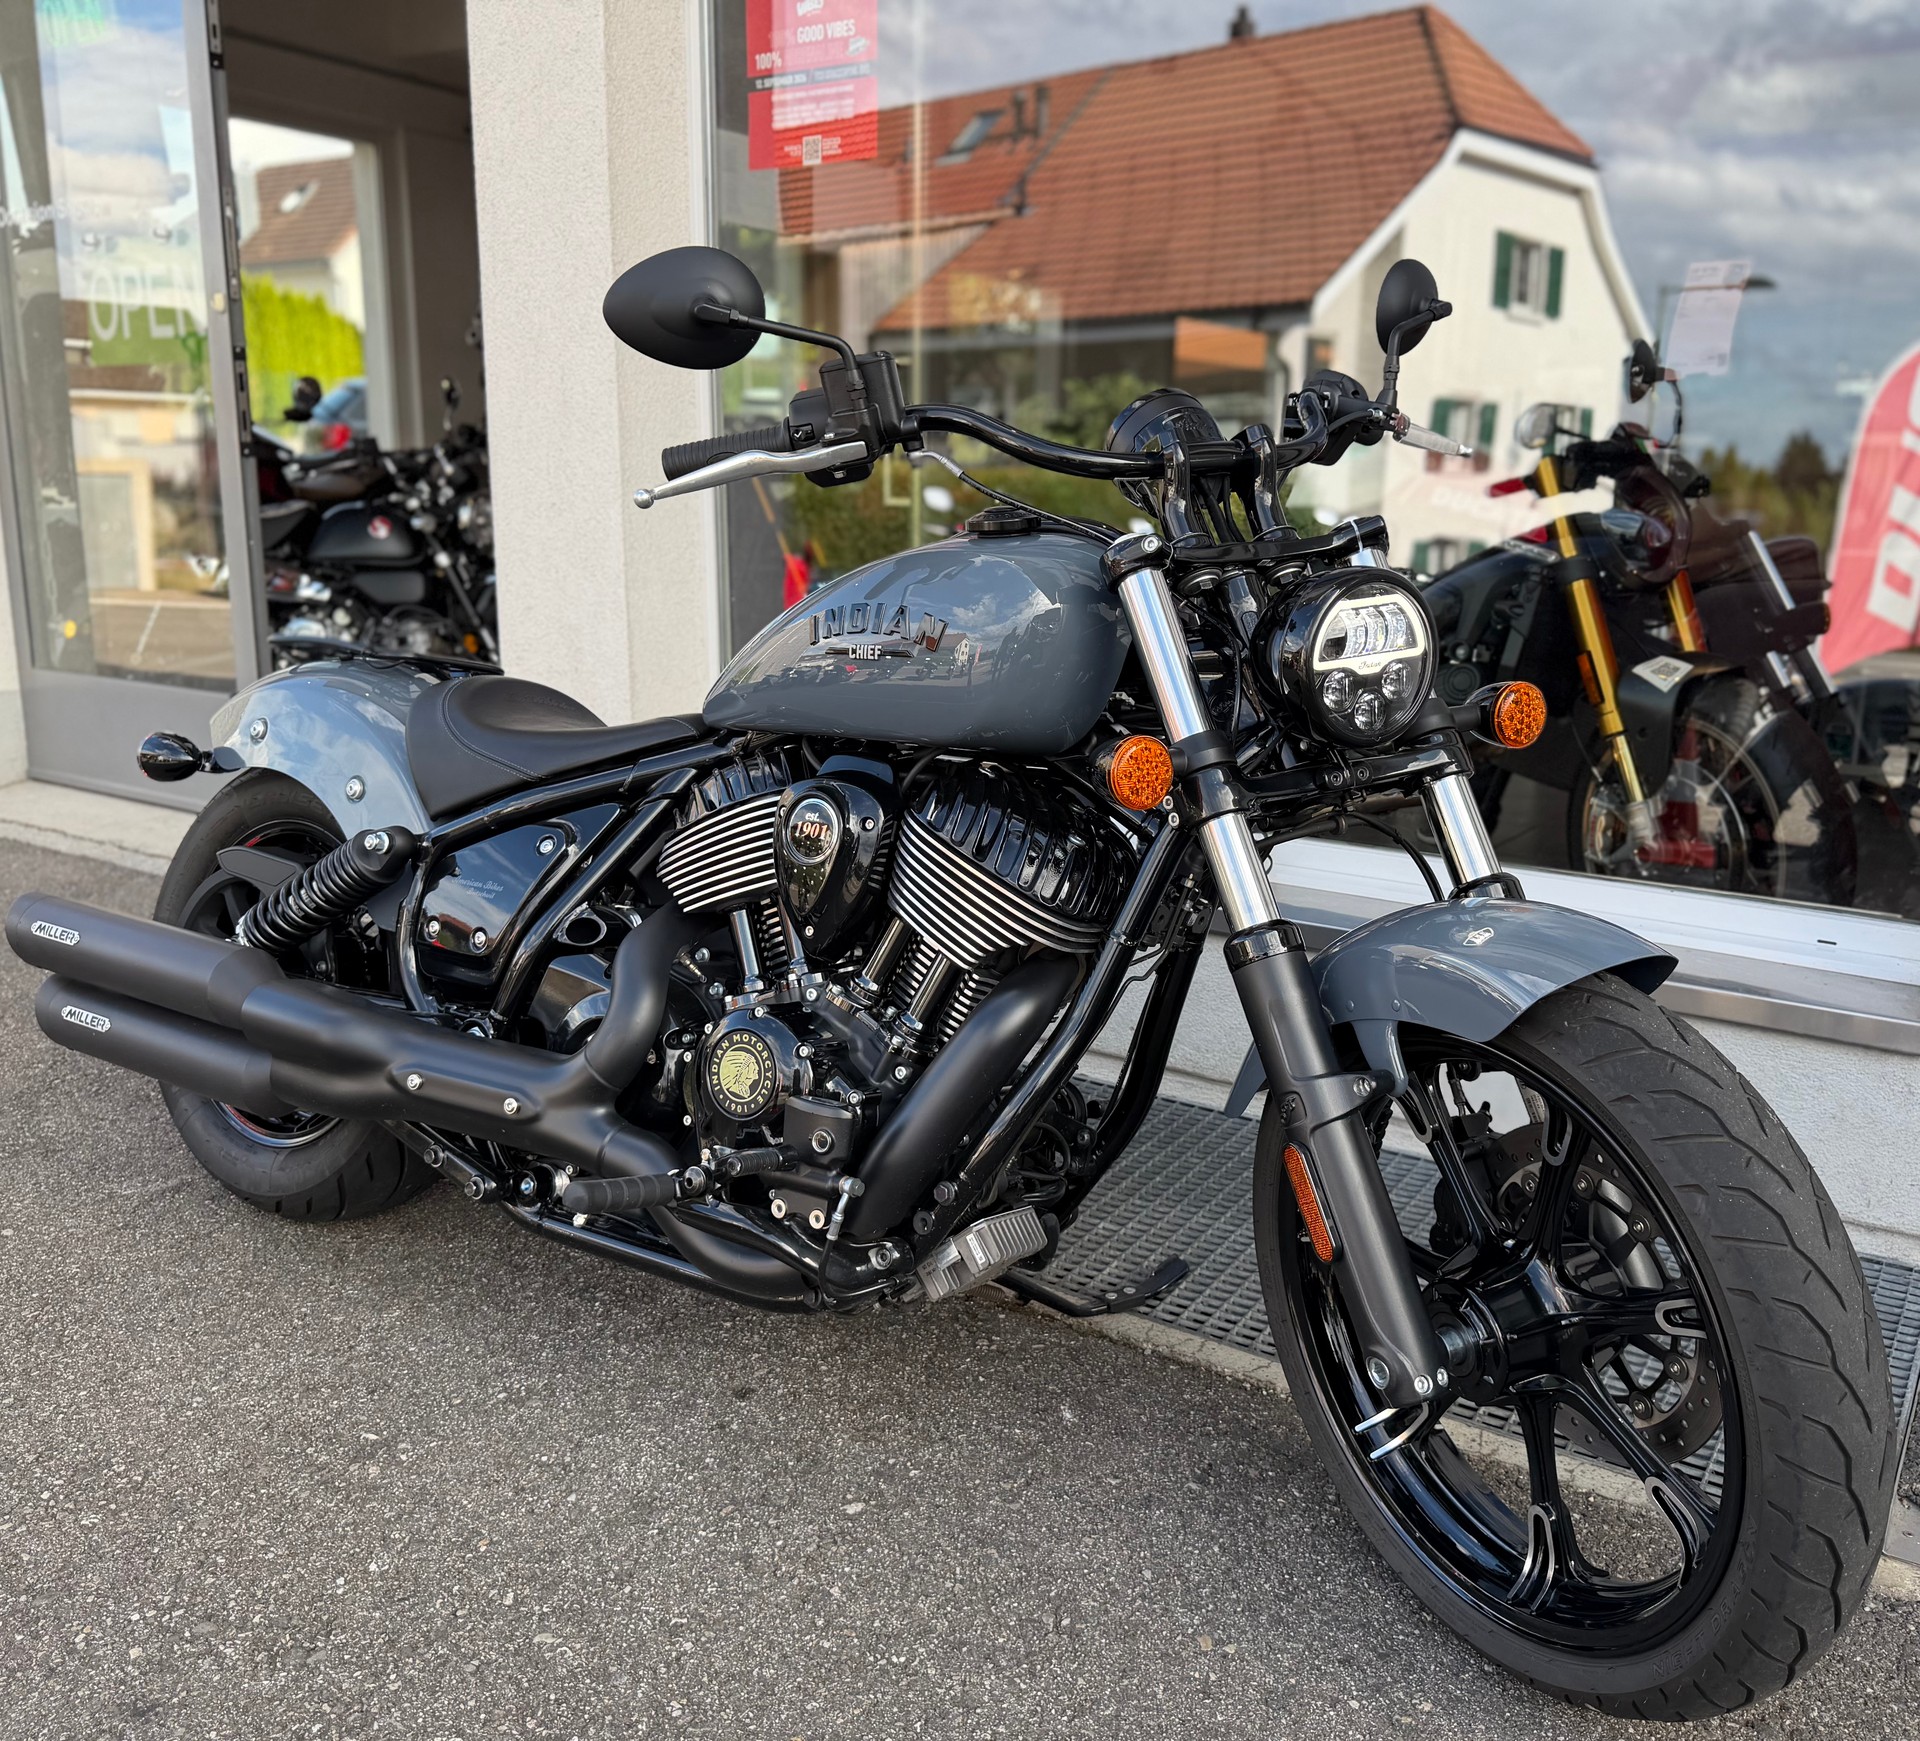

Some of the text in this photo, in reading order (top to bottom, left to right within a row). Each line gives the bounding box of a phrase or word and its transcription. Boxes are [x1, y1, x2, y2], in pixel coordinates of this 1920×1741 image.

[797, 18, 855, 43] GOOD VIBES
[755, 51, 782, 70] 100%
[88, 262, 208, 341] OPEN
[808, 602, 949, 653] INDIAN
[848, 644, 883, 660] CHIEF
[805, 811, 820, 821] est.
[795, 821, 828, 840] 1901
[34, 923, 75, 943] MILLER
[65, 1008, 106, 1029] MILLER
[711, 1033, 773, 1104] INDIAN MOTORCYCLE
